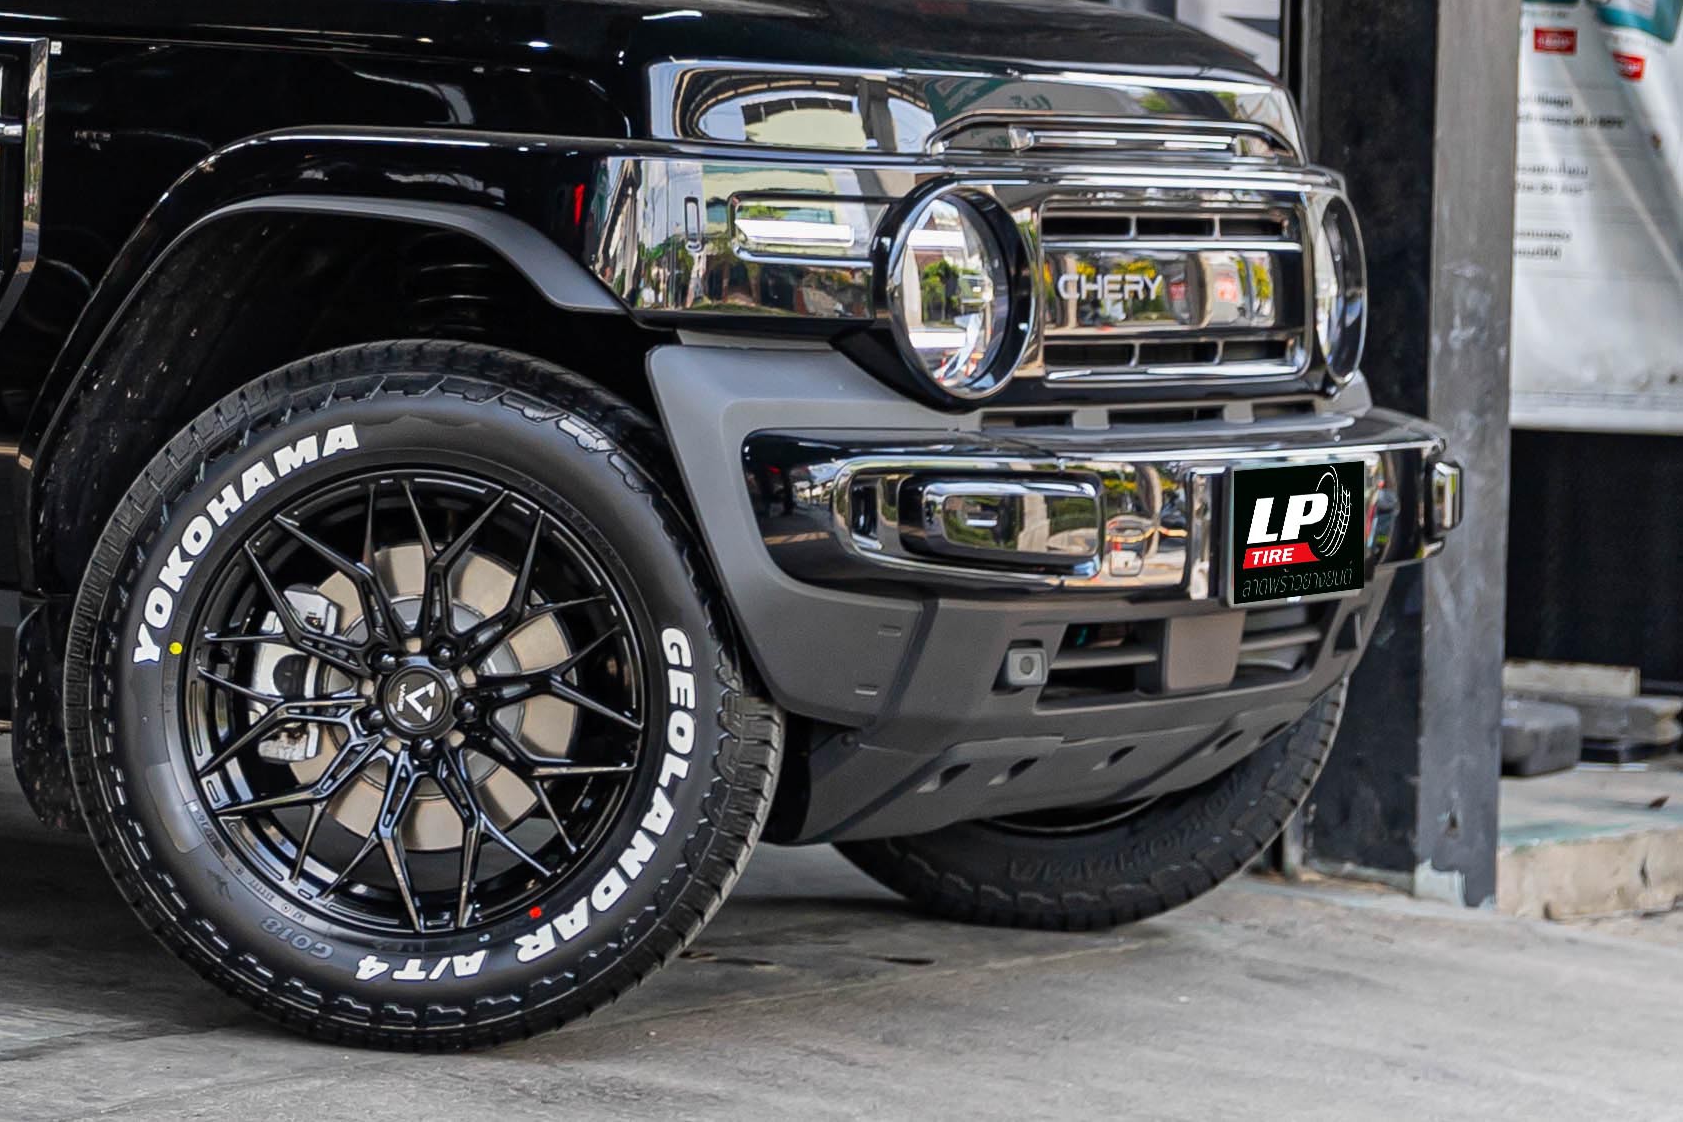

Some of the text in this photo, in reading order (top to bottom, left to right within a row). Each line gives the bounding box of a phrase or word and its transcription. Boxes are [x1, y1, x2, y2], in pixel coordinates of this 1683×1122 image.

[1057, 273, 1164, 301] CHERY
[132, 423, 361, 665] YOKOHAMA
[513, 627, 702, 966] GEOLANDAR
[354, 951, 485, 982] A/T4
